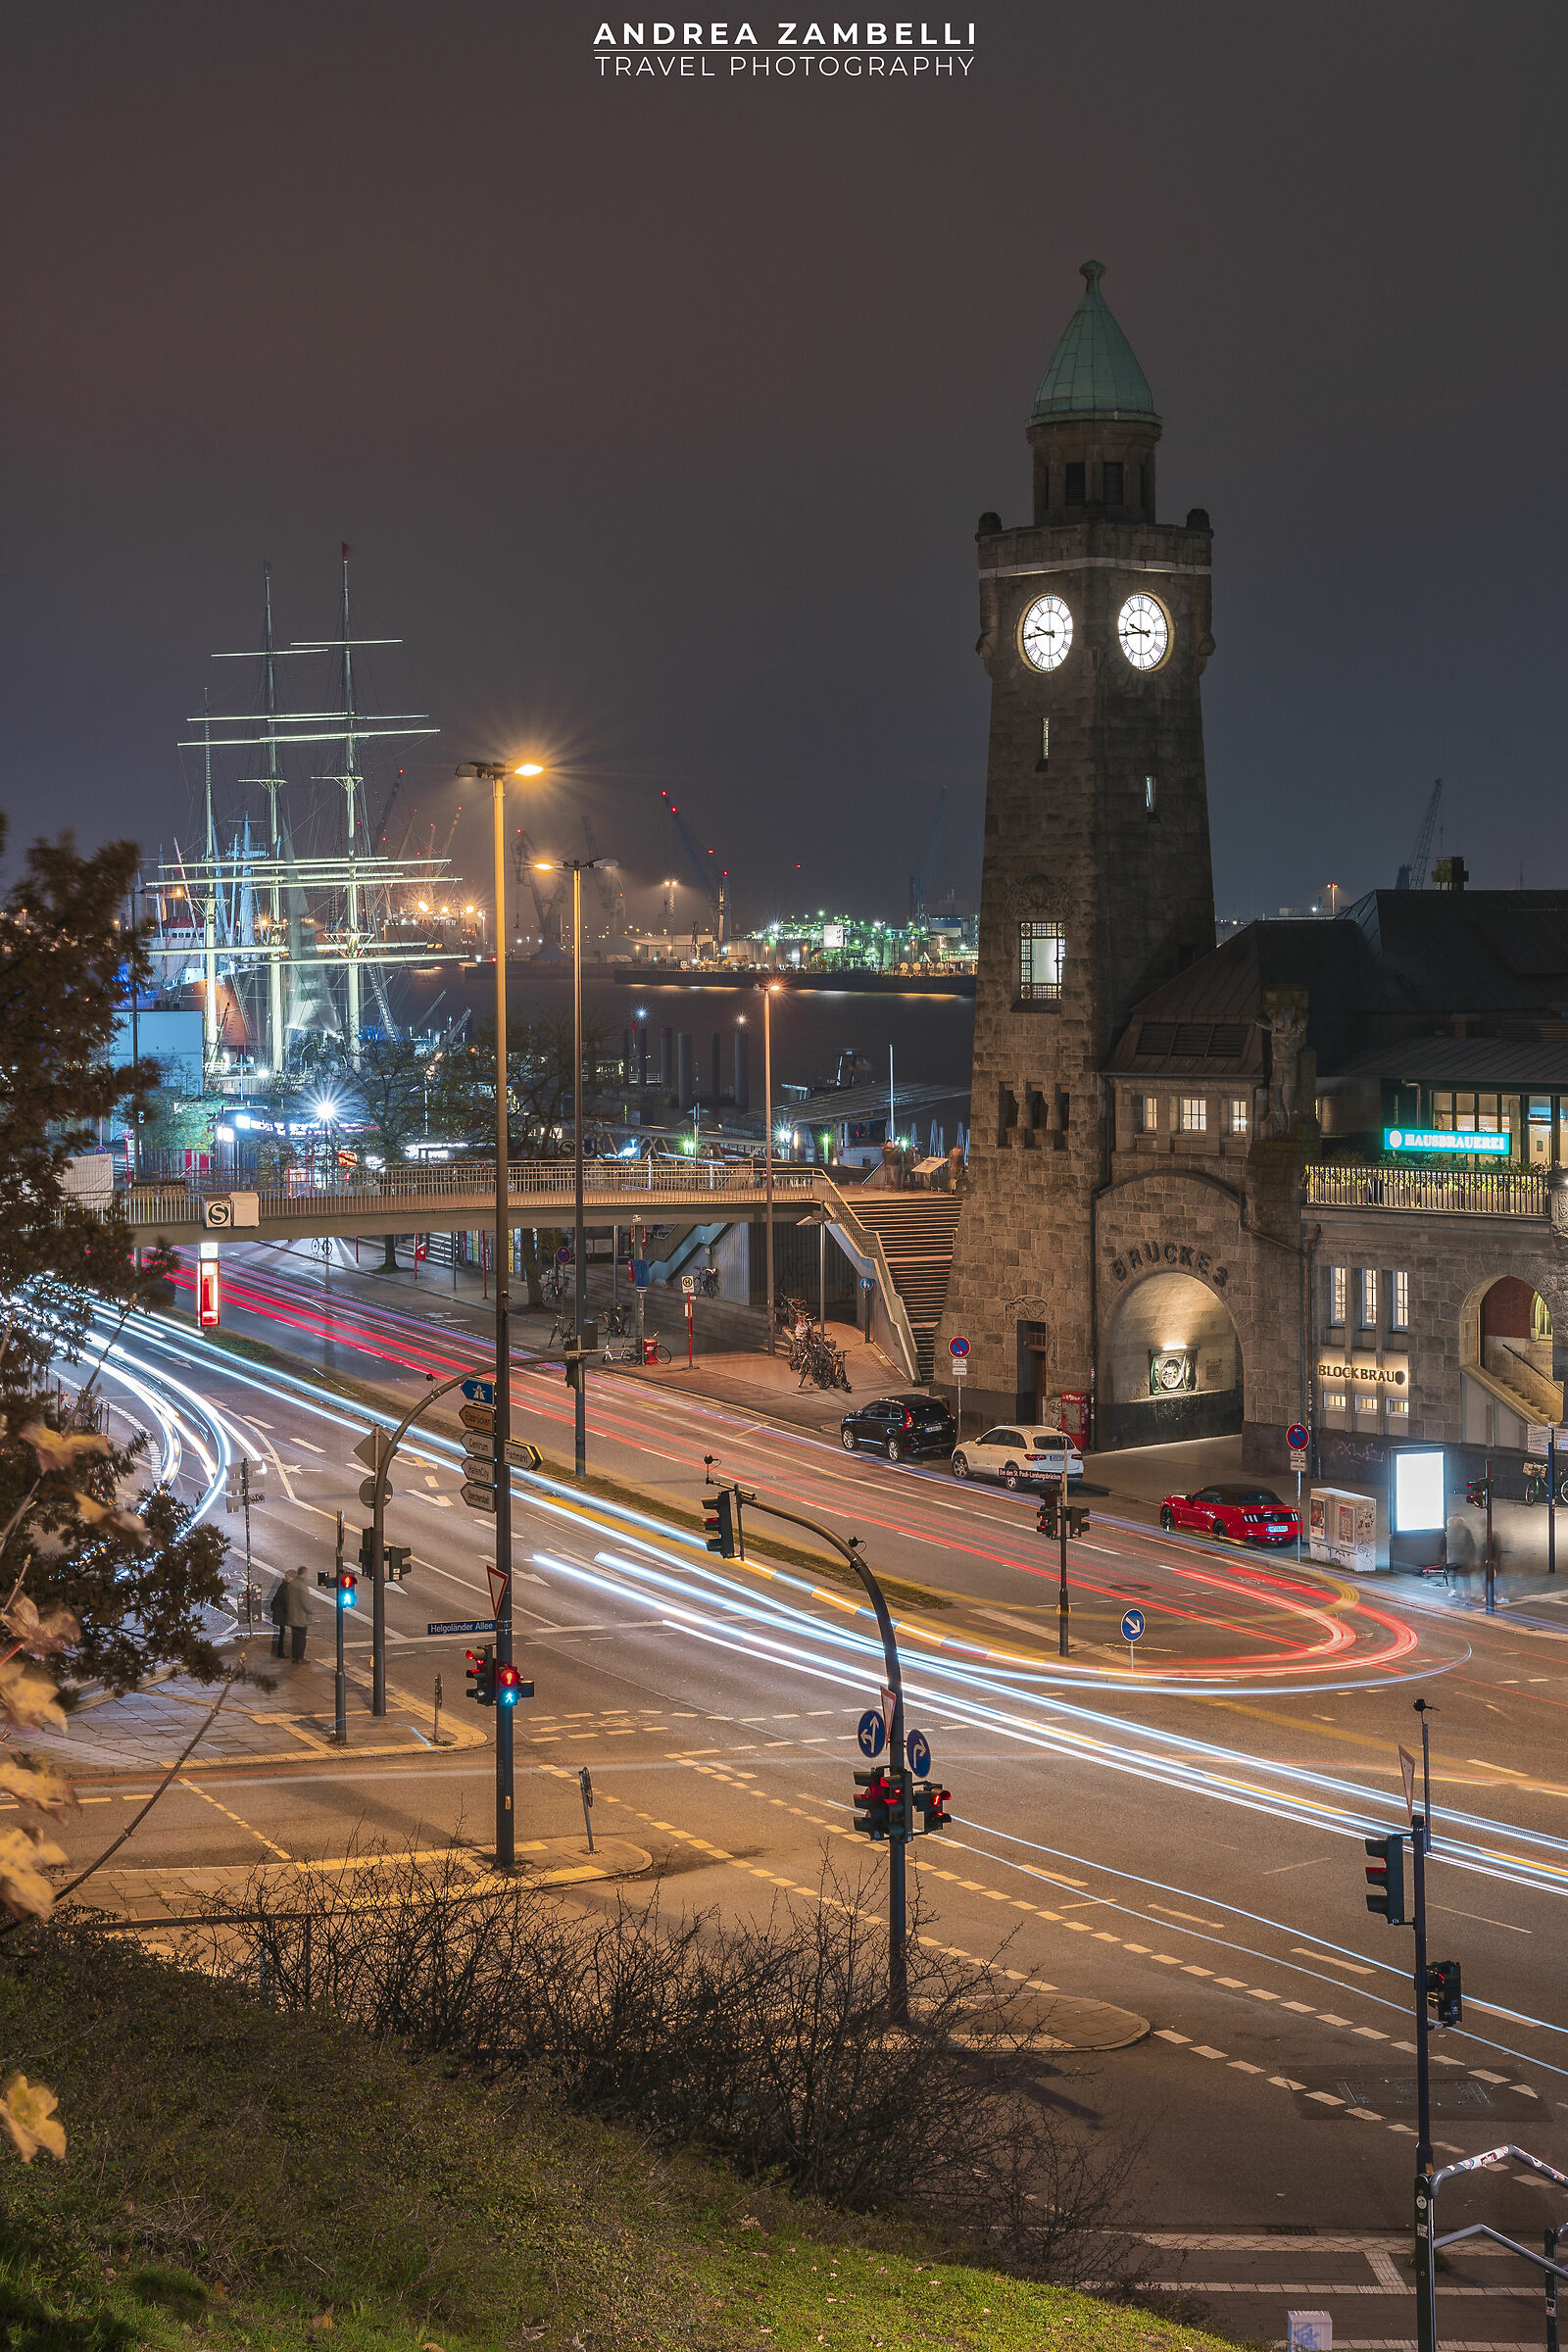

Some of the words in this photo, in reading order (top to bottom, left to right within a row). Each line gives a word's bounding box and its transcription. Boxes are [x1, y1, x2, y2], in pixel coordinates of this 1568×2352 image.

[1404, 1134, 1504, 1150] HAUSBRAUEREI
[209, 1203, 229, 1225] S
[1212, 1266, 1229, 1288] 3
[468, 1438, 489, 1451] Centrum
[506, 1447, 528, 1464] Fischmarkt
[430, 1623, 473, 1634] Helgoländer
[474, 1621, 493, 1631] Allee
